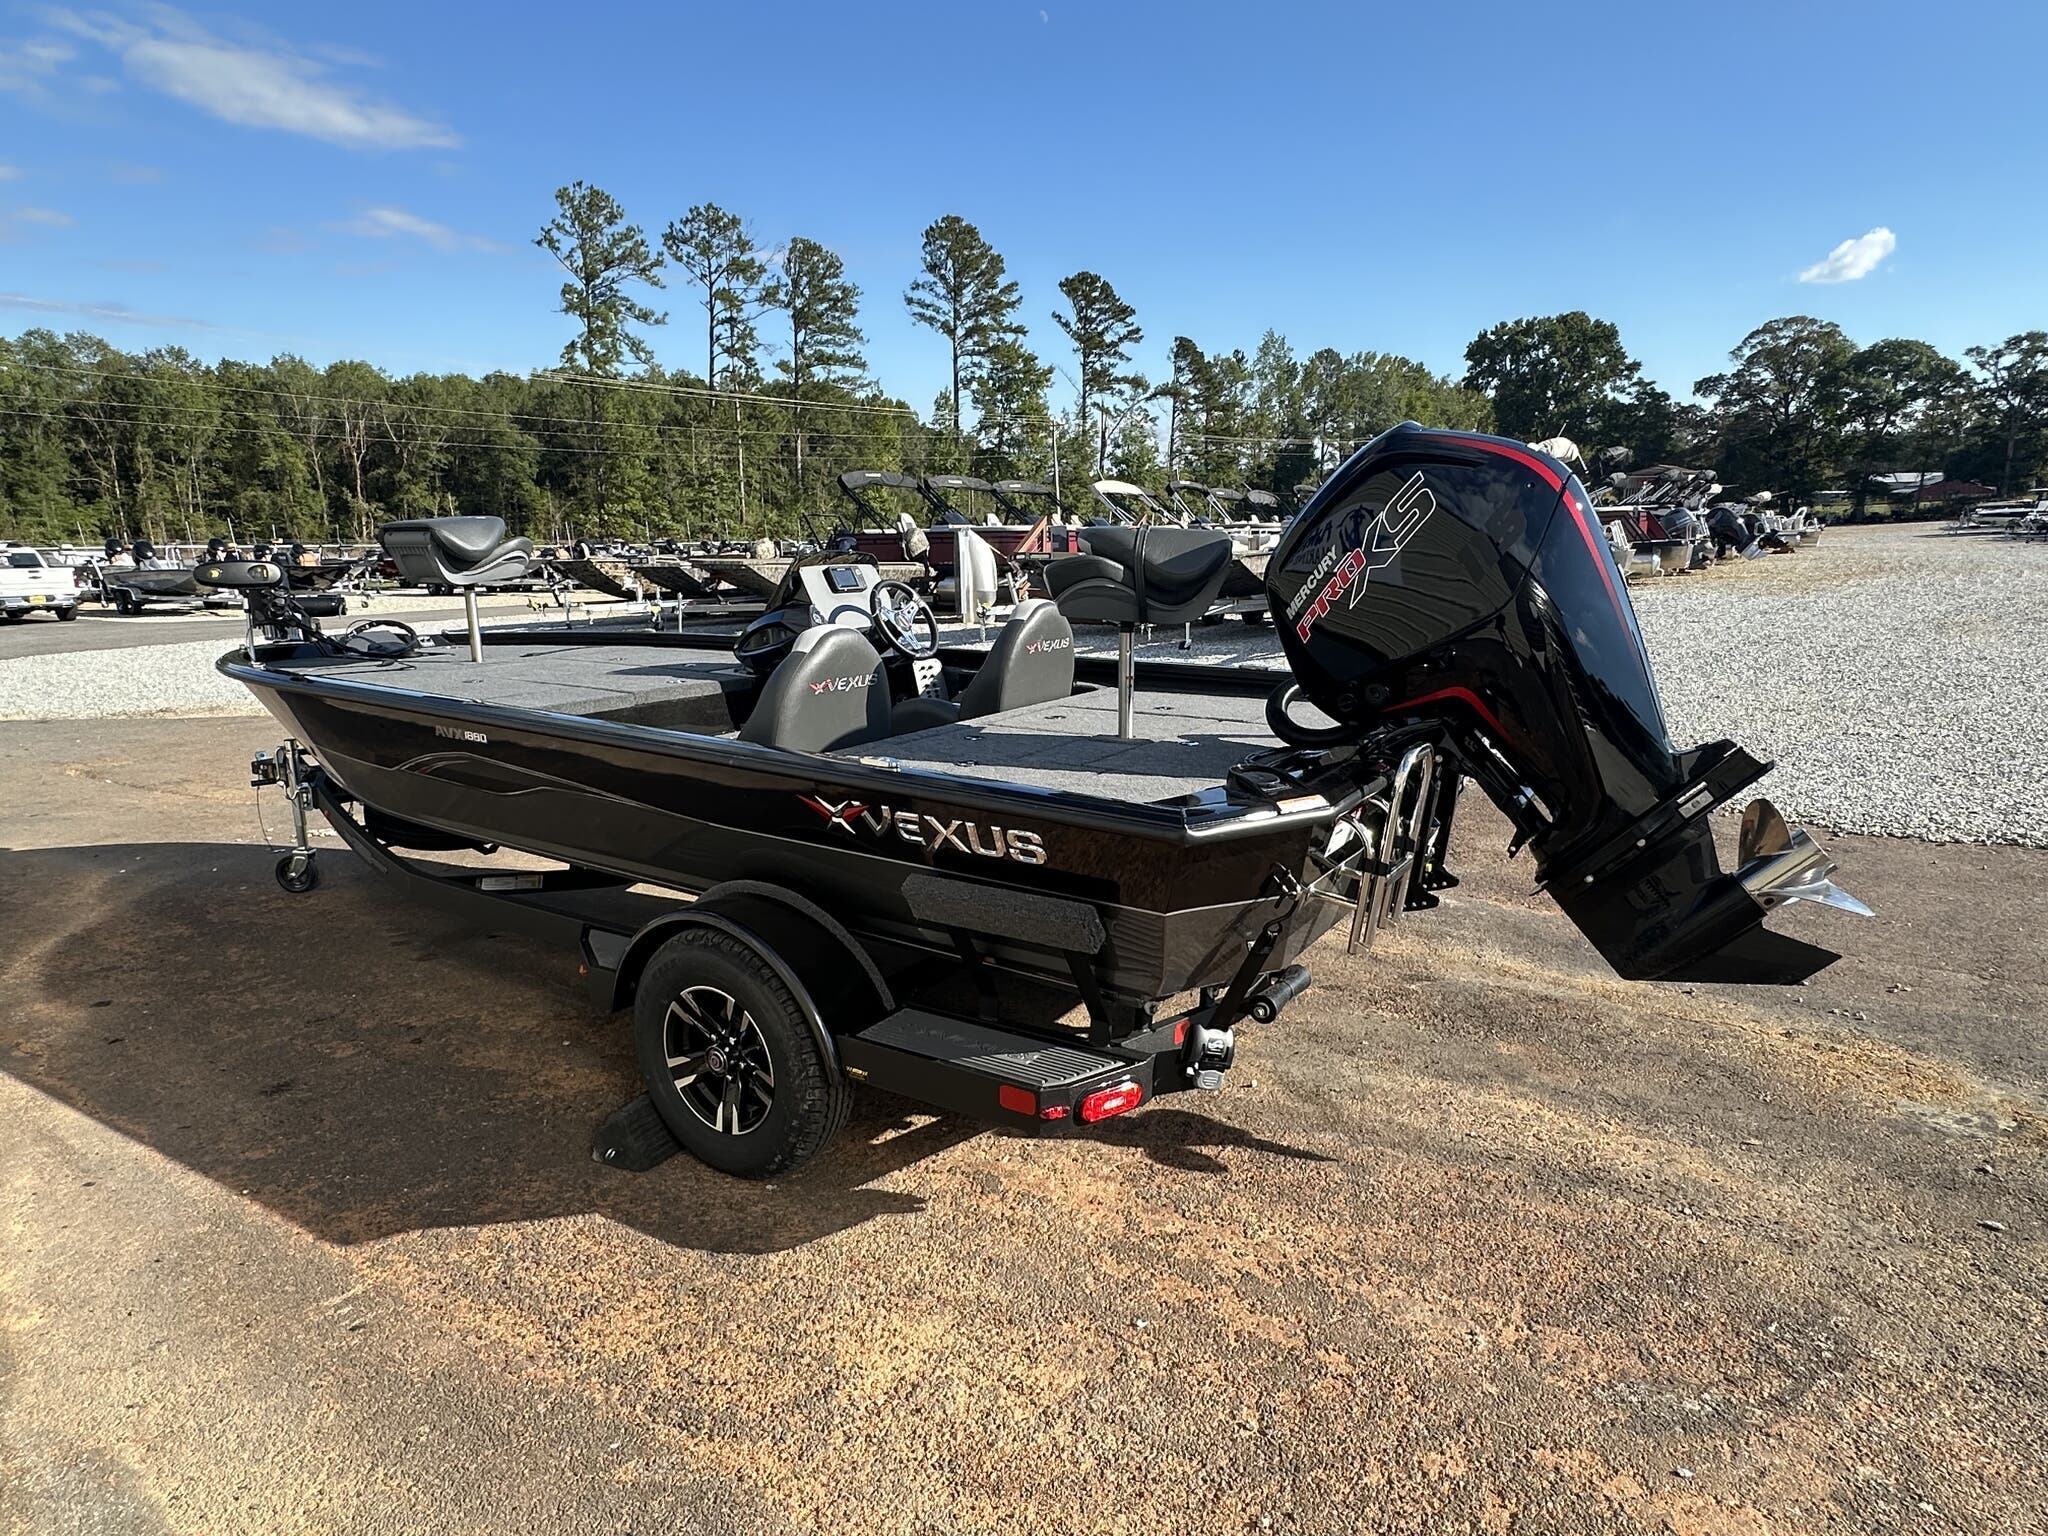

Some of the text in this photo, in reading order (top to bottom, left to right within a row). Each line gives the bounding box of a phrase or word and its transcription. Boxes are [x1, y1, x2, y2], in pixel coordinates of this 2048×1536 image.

[1285, 545, 1338, 620] MERCURY
[1037, 637, 1070, 653] VEXUS
[828, 673, 878, 692] VEXUS
[851, 800, 1049, 865] VEXUS
